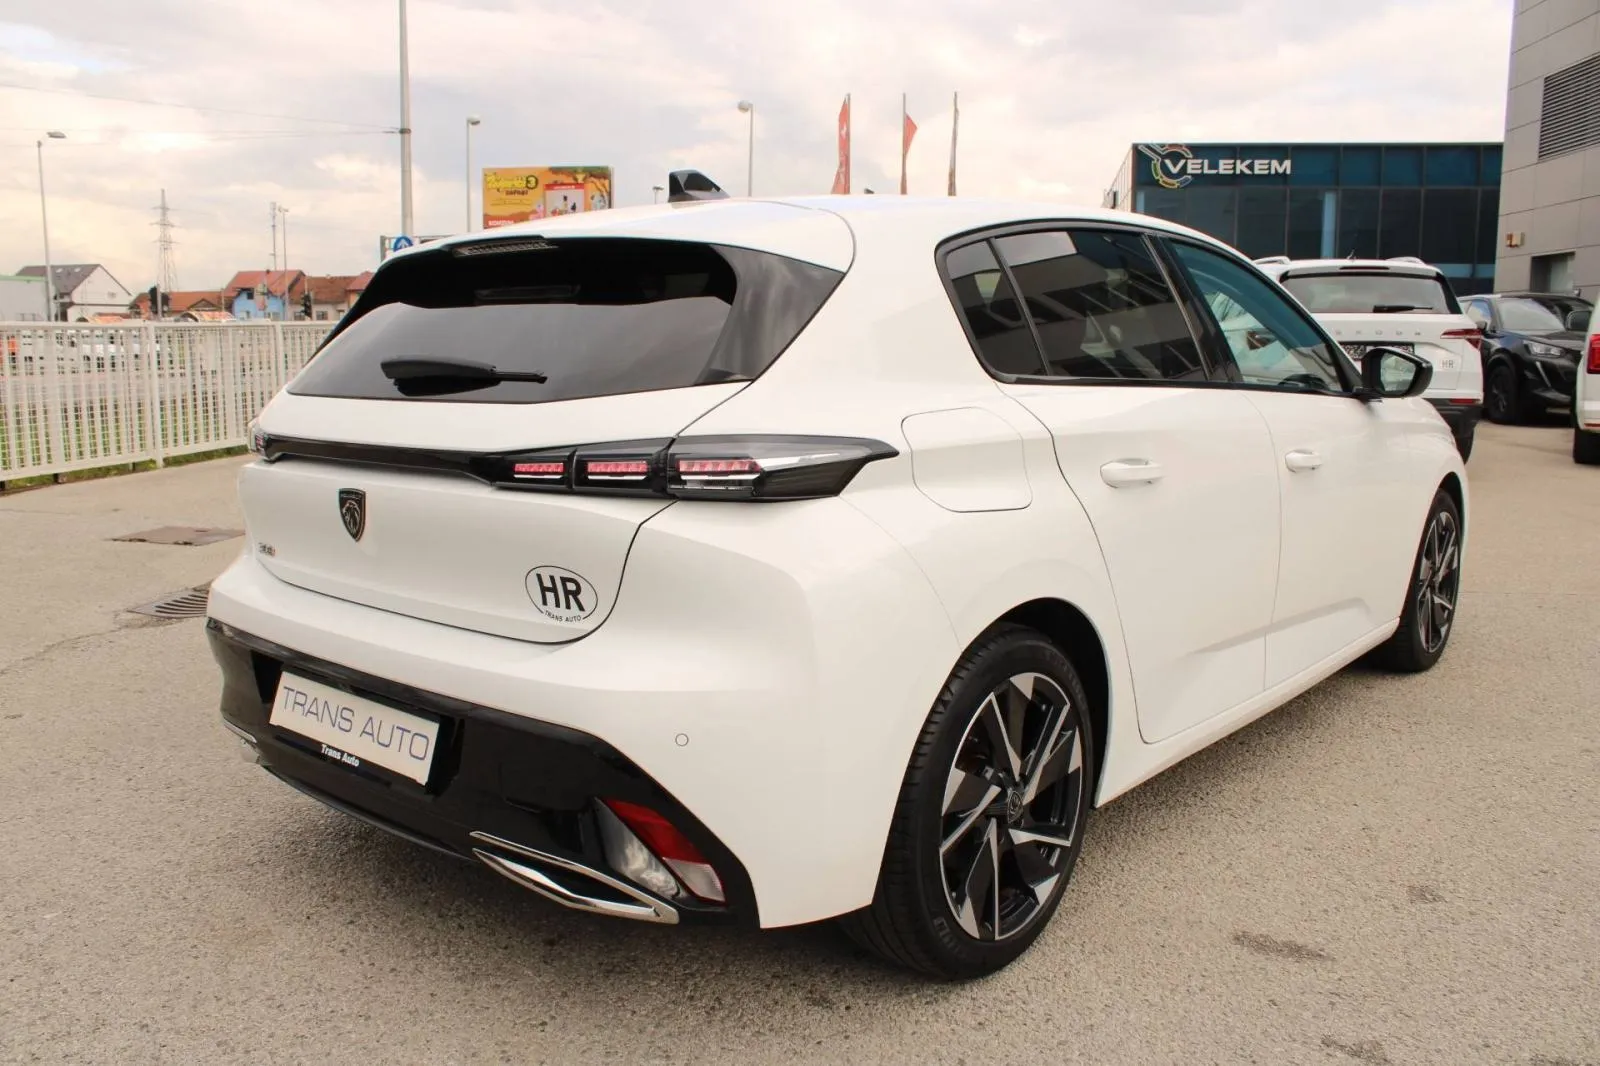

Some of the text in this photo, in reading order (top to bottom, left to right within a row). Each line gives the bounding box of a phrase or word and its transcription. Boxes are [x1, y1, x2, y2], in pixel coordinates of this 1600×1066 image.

[1163, 159, 1291, 175] VELEKEM
[1441, 359, 1454, 369] HR
[536, 573, 586, 612] HR
[544, 610, 582, 622] TRANS AUTO
[283, 686, 430, 761] TRANS AUTO
[321, 743, 360, 767] Trans Auto
